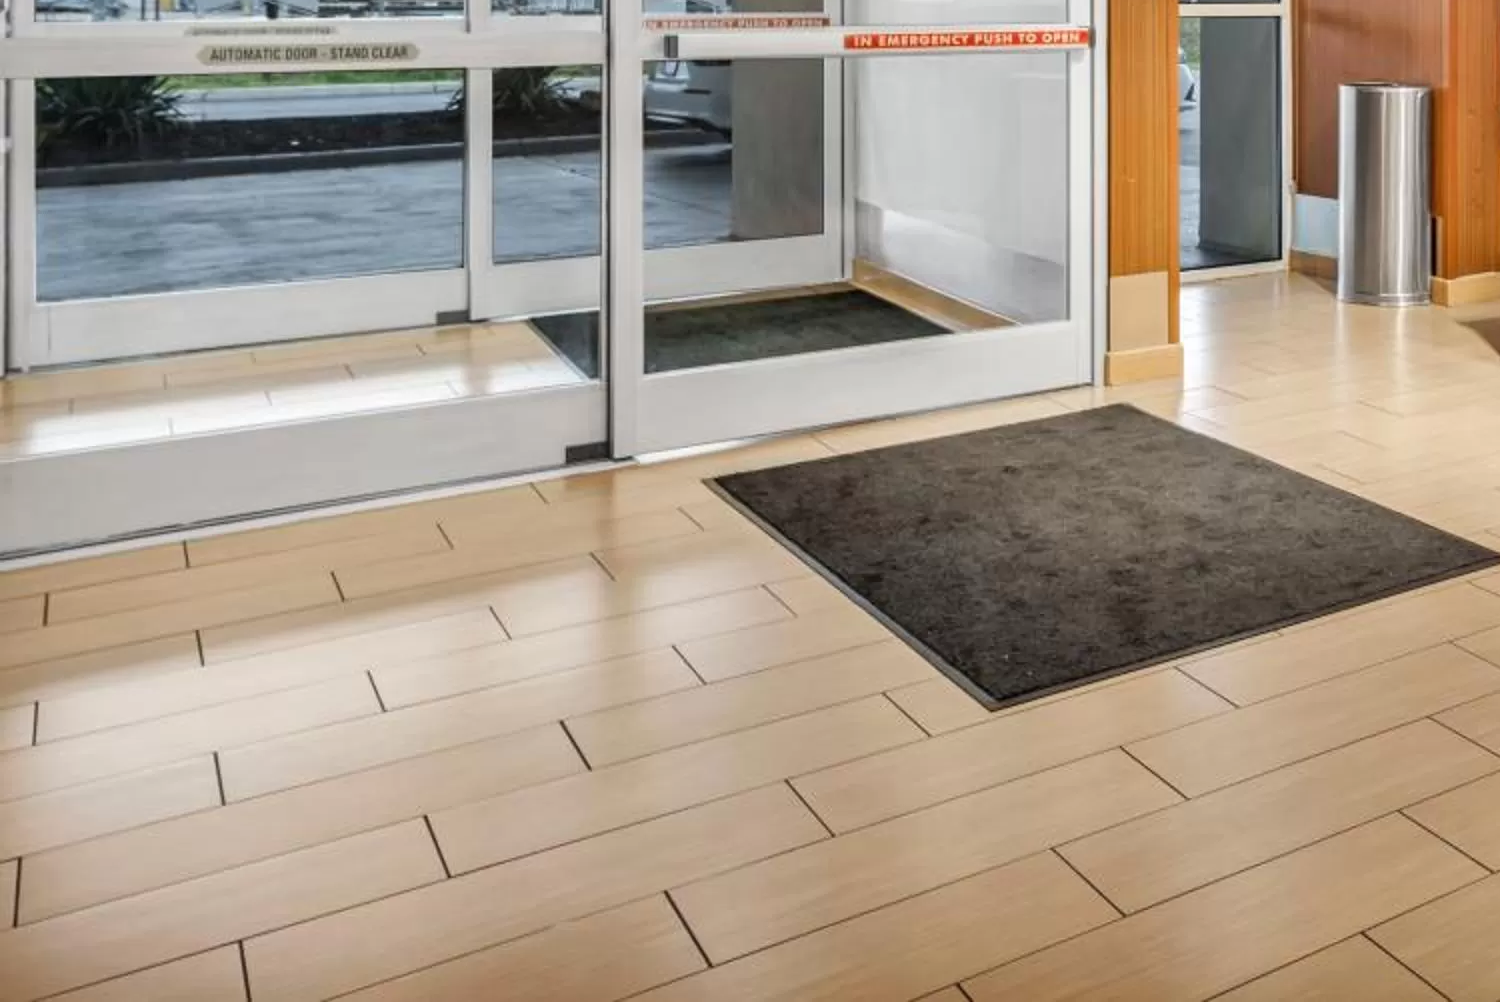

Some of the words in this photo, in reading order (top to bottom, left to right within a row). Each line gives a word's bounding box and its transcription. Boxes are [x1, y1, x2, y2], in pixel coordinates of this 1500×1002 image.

[853, 36, 872, 47] IN
[878, 35, 969, 47] EMERGENCY
[974, 34, 1013, 45] PUSH
[1018, 33, 1035, 44] TO
[1043, 32, 1080, 43] OPEN
[209, 46, 281, 62] AUTOMATIC
[285, 46, 317, 61] DOOR
[330, 45, 368, 60] STAND
[371, 45, 408, 60] CLEAR
